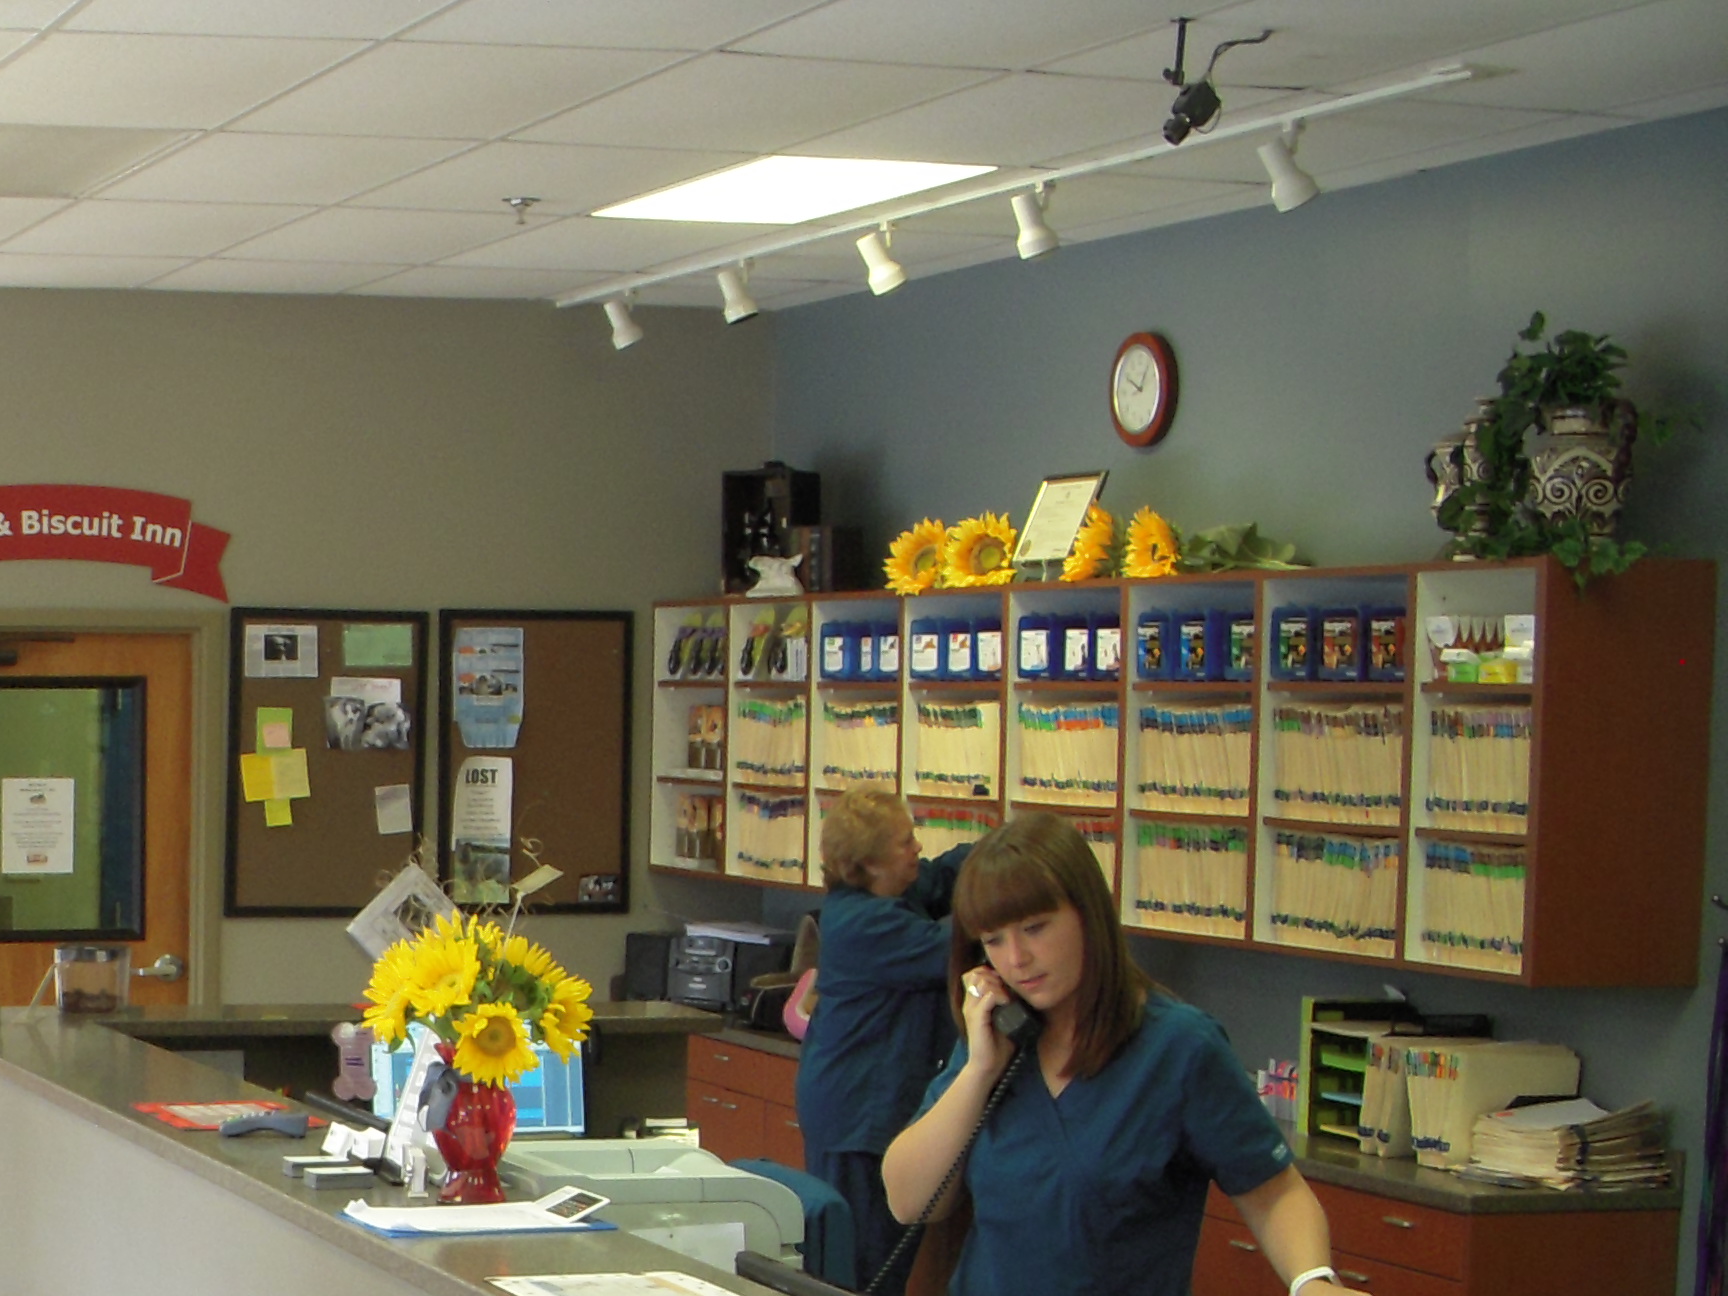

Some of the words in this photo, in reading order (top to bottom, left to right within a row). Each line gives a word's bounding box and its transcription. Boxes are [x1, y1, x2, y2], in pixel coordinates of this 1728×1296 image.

[21, 509, 123, 538] Biscuit
[130, 515, 182, 547] Inn
[465, 768, 498, 784] LOST
